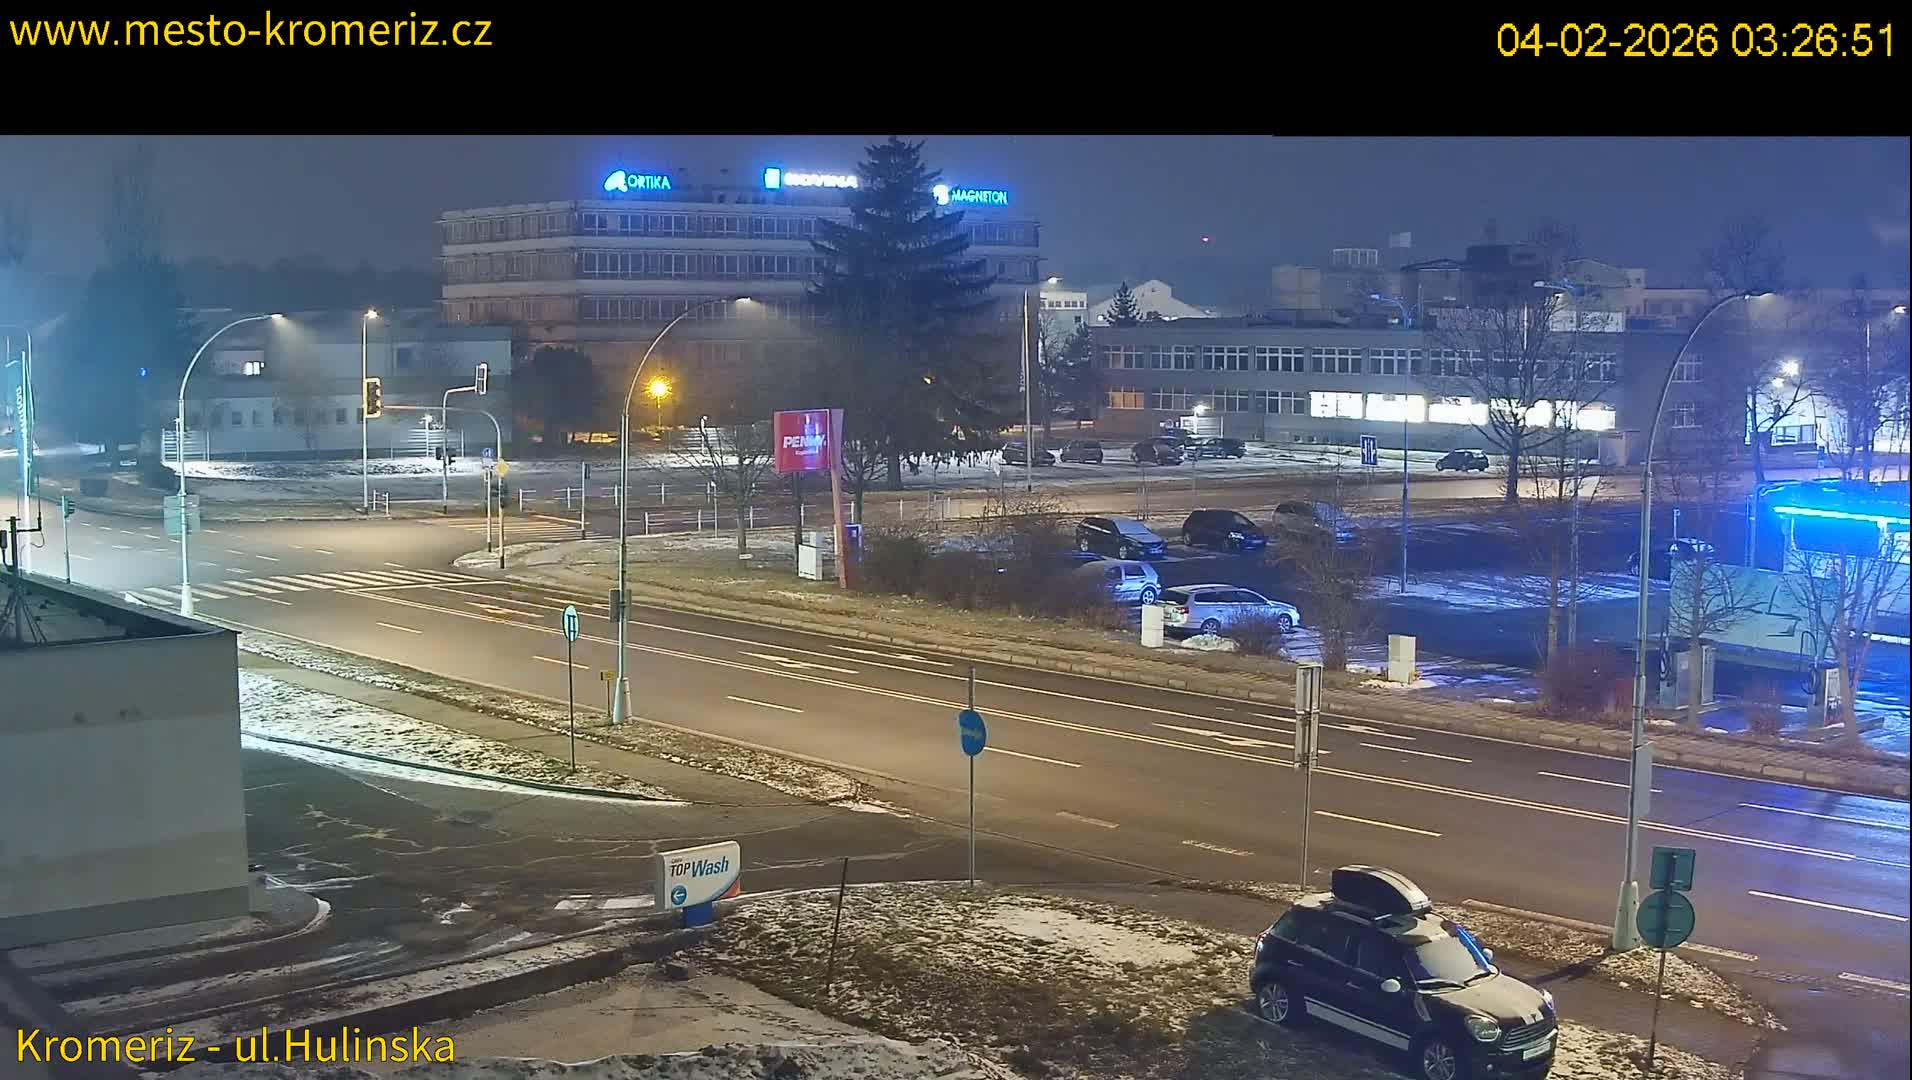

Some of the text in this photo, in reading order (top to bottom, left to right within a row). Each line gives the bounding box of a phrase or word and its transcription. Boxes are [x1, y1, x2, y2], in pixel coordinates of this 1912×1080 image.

[627, 174, 672, 190] ORTIKA
[951, 189, 1009, 206] MAGNETON
[670, 856, 729, 878] TOP Wash
